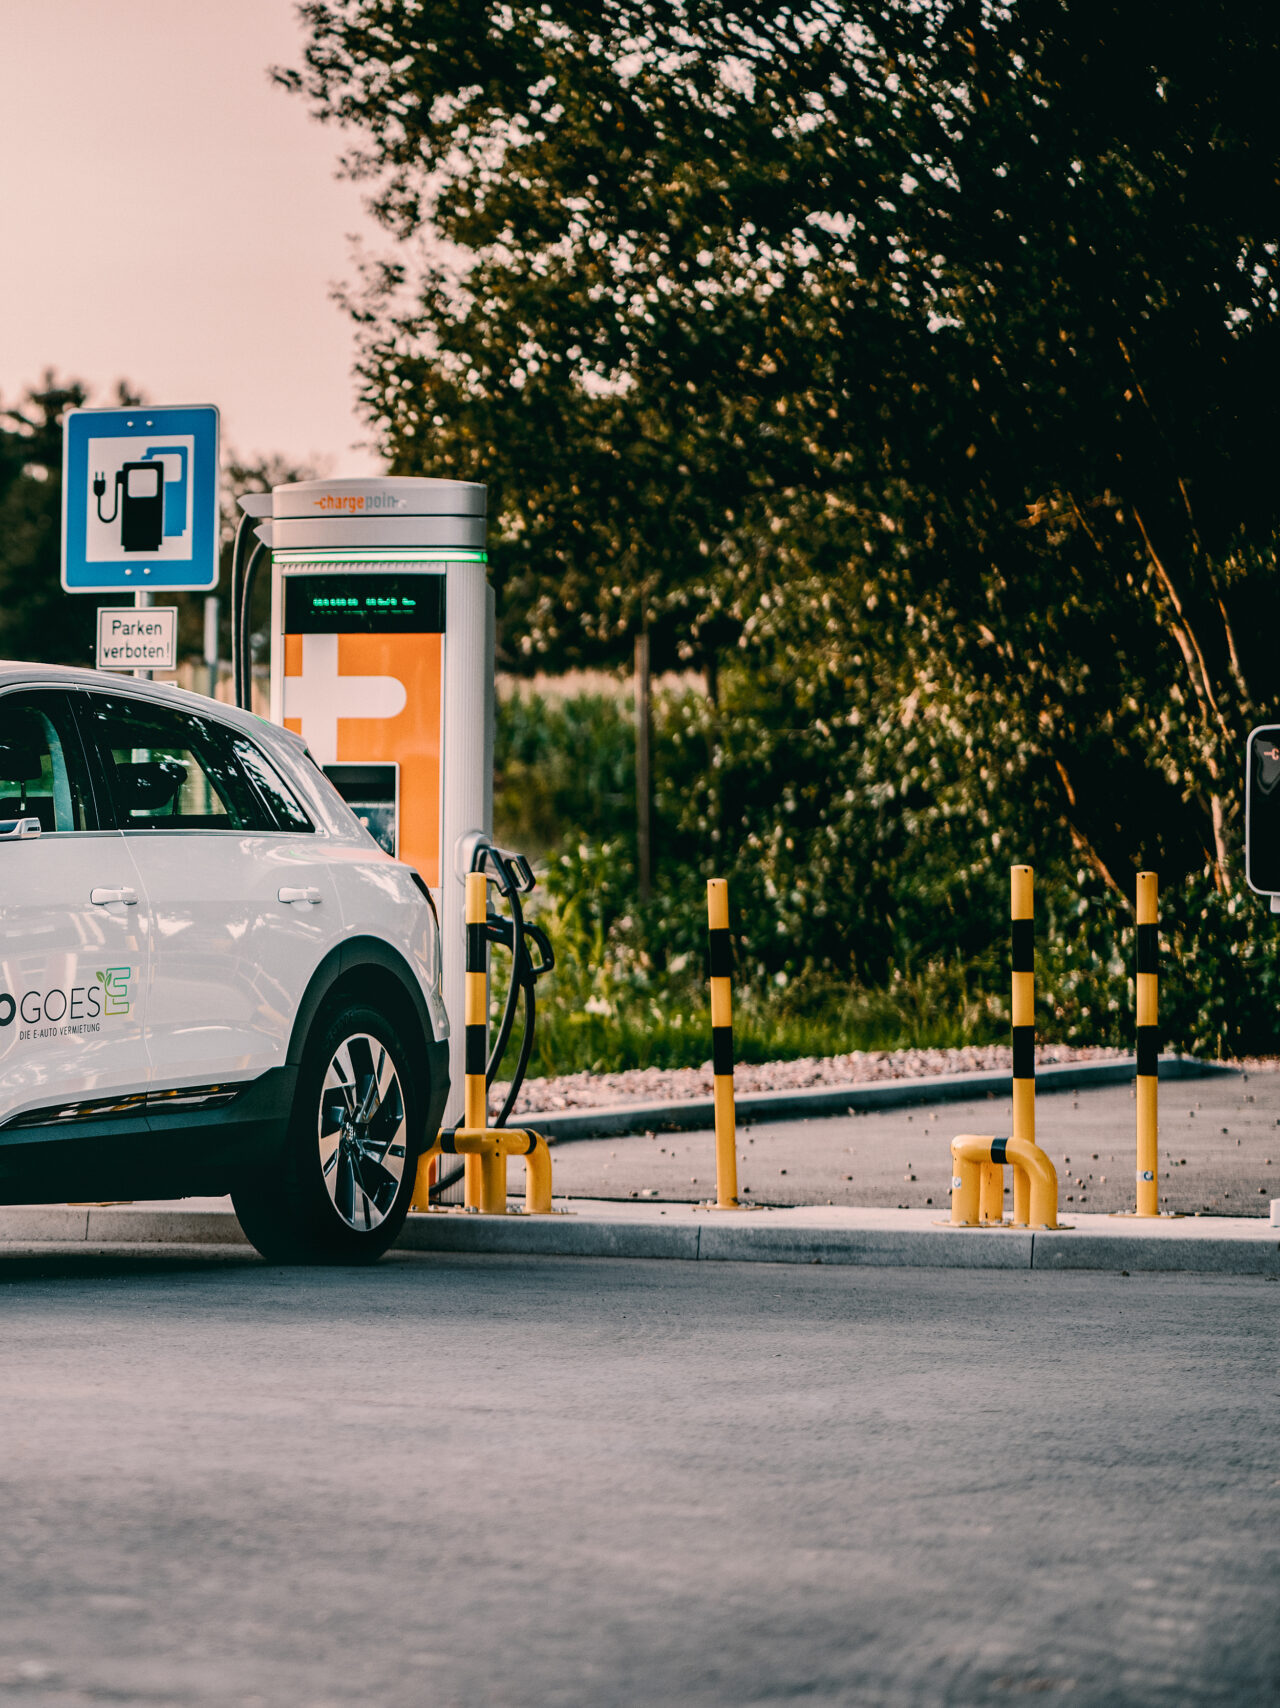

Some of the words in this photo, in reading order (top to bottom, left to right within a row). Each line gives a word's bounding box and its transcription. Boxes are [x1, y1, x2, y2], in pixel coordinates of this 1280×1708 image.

[112, 619, 162, 635] Parken
[103, 641, 170, 658] verboten!
[20, 1030, 30, 1040] DIE
[33, 1027, 57, 1039] E-AUTO
[60, 1023, 100, 1035] VERMIETUNG
